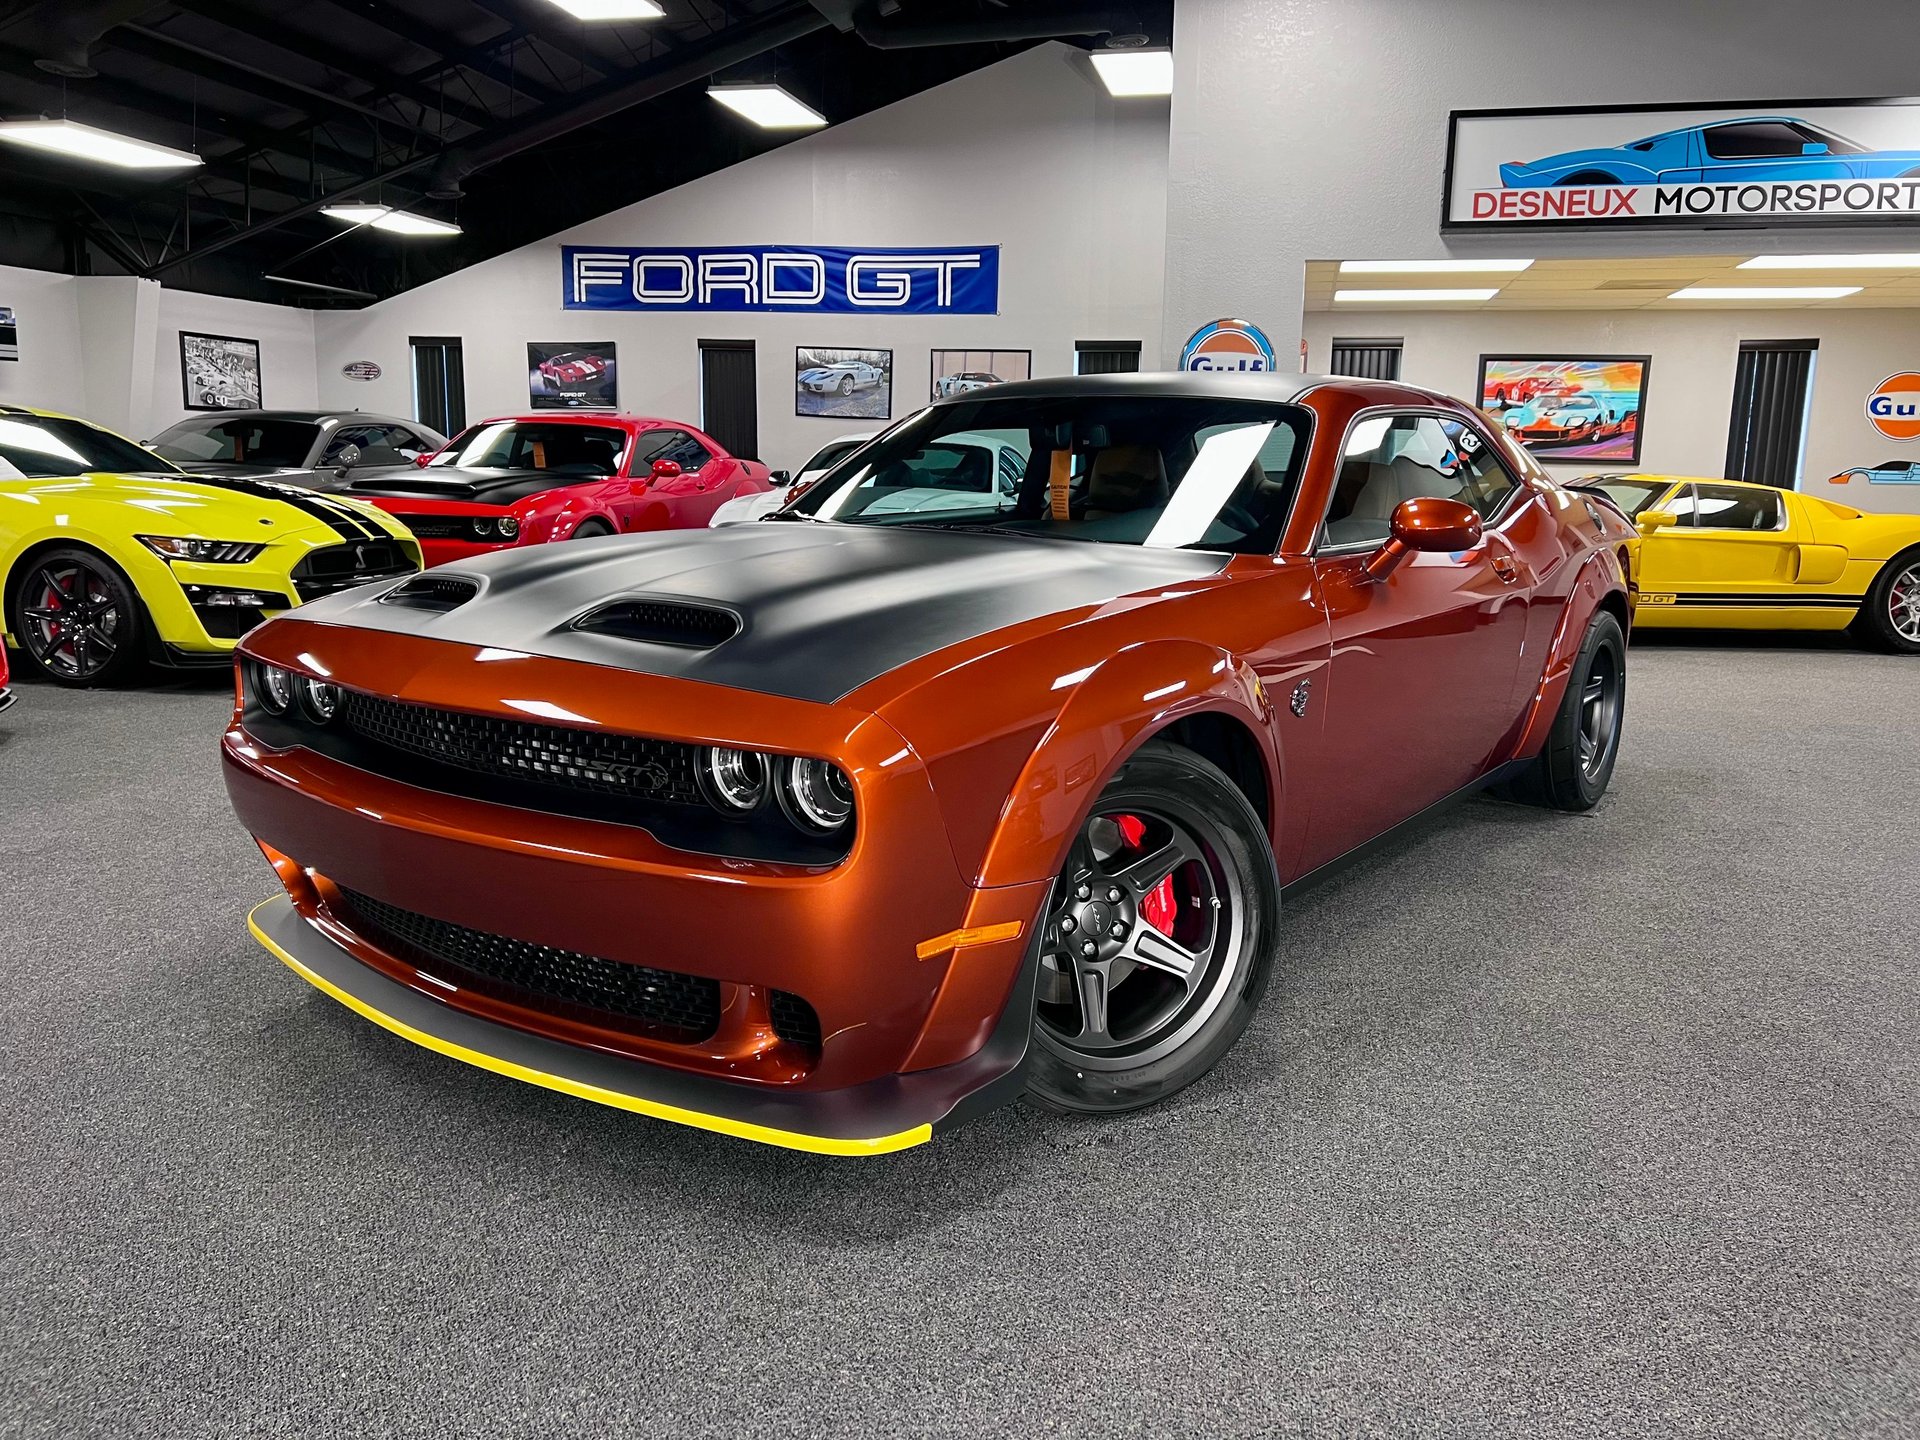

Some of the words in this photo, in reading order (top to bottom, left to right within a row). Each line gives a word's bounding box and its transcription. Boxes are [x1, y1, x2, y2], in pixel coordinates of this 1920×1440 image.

[1472, 188, 1638, 218] DESNEUX
[1654, 181, 1920, 214] MOTORSPORT
[573, 253, 825, 305] FORD
[846, 254, 981, 307] GT
[1653, 594, 1674, 603] GT
[585, 760, 652, 779] SRT
